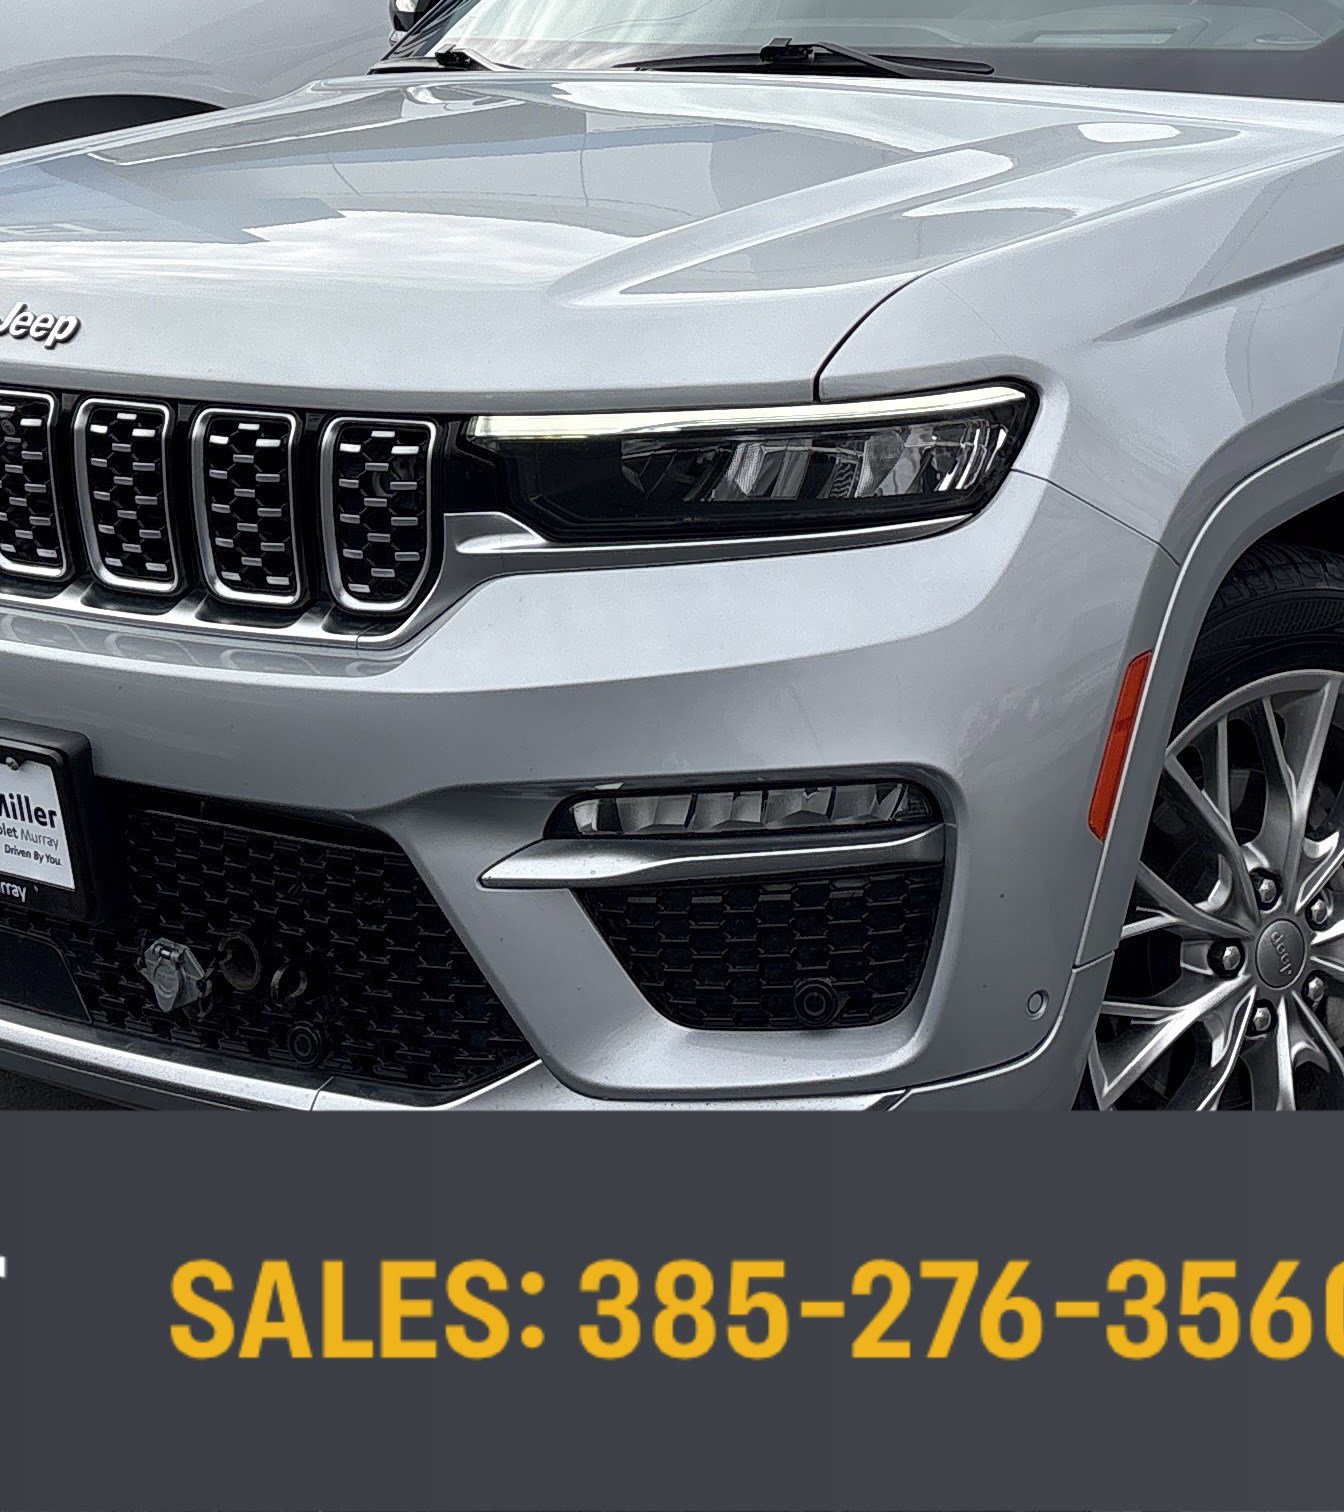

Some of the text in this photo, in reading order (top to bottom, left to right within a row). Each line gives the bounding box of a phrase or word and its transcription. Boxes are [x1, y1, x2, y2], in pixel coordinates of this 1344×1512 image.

[19, 829, 60, 851] Murray
[3, 843, 32, 859] Driven
[32, 850, 45, 864] By
